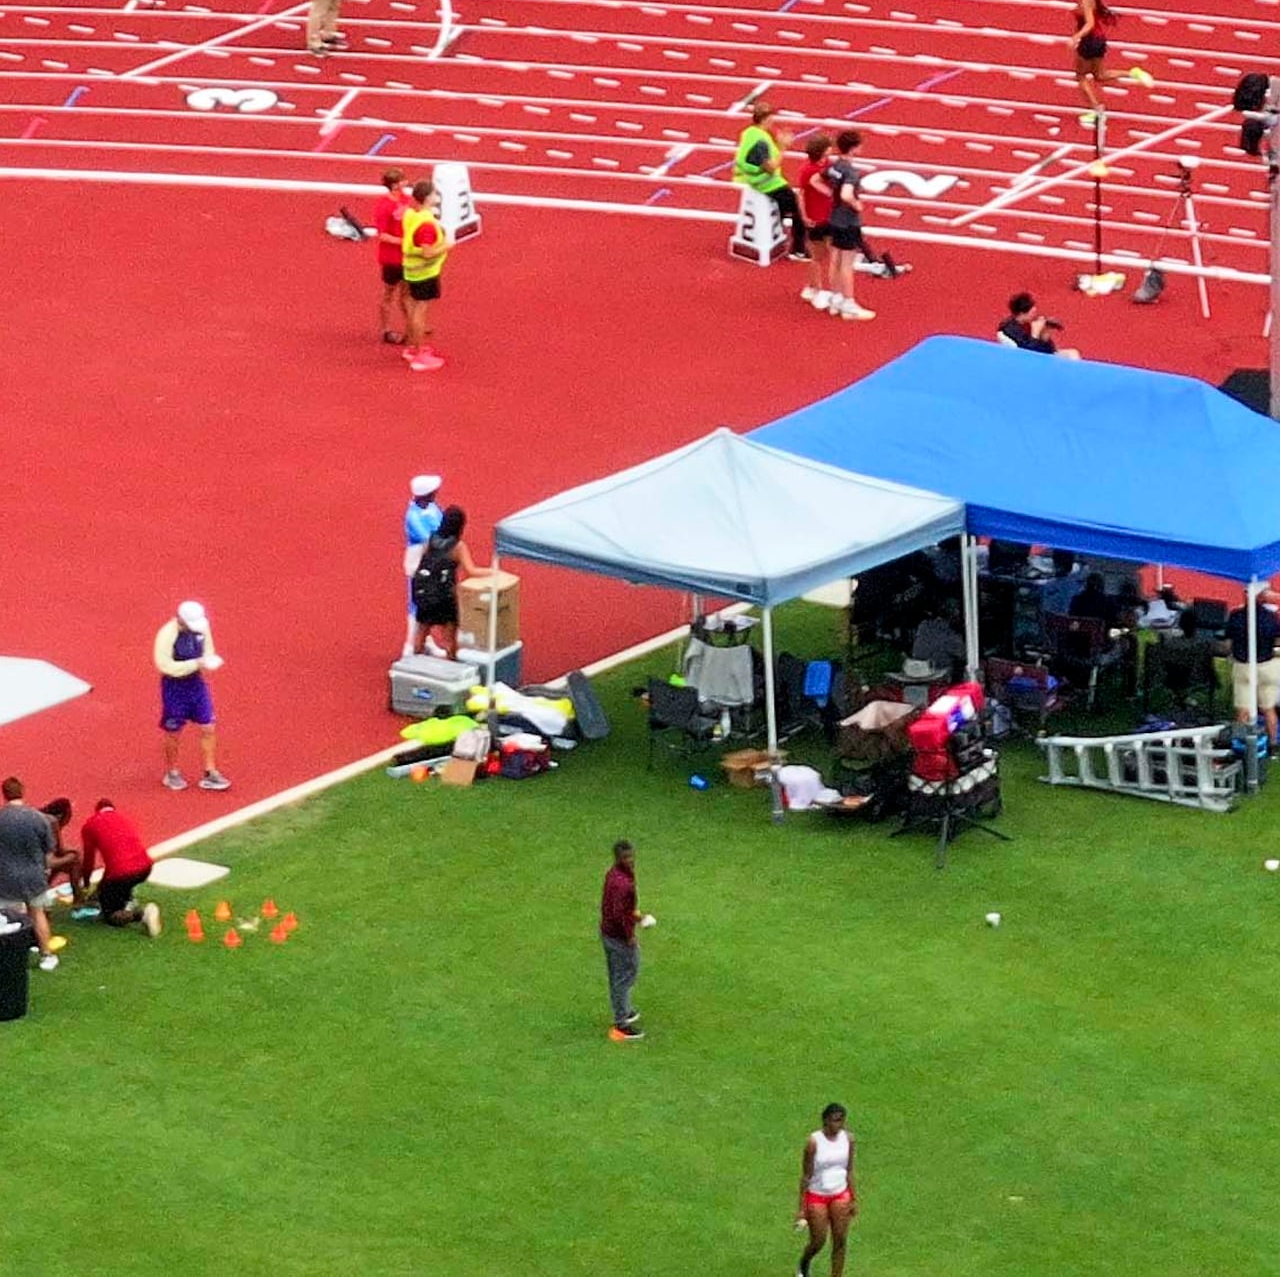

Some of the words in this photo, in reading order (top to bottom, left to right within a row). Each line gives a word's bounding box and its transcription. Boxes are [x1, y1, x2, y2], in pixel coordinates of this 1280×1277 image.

[861, 171, 958, 197] 2
[458, 190, 471, 221] 3
[743, 210, 755, 242] 2
